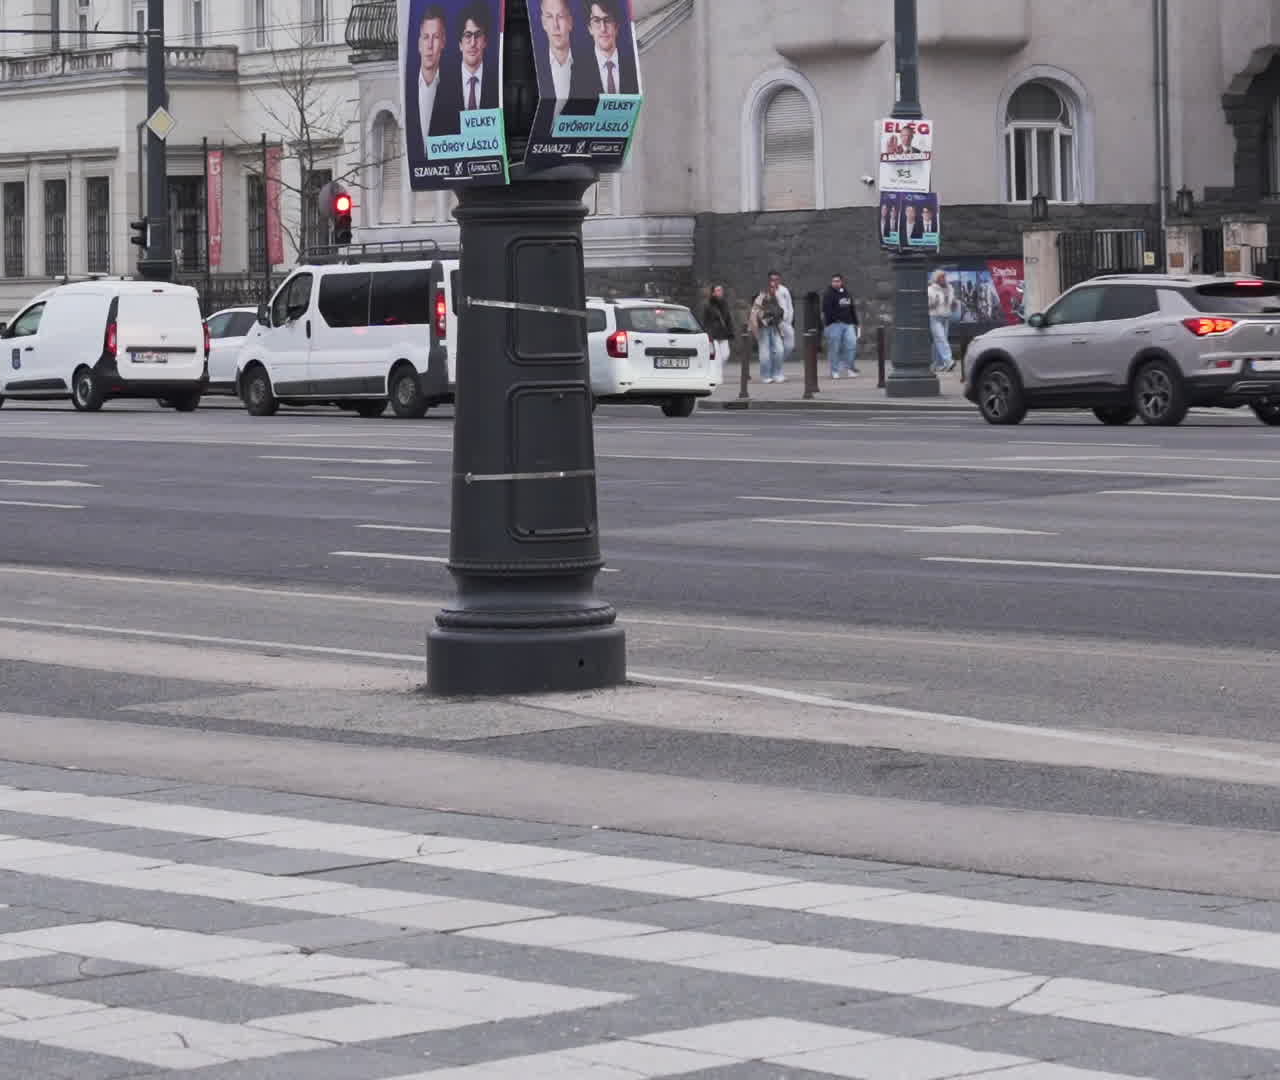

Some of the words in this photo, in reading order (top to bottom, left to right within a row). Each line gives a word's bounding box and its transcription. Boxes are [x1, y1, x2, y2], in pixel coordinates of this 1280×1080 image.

[602, 100, 634, 111] VELKEY
[465, 116, 497, 128] VELKEY
[558, 122, 594, 132] GYÖRGY
[596, 120, 629, 132] LÁSZLÓ
[431, 140, 465, 154] GYÖRGY
[466, 138, 499, 151] LÁSZLÓ
